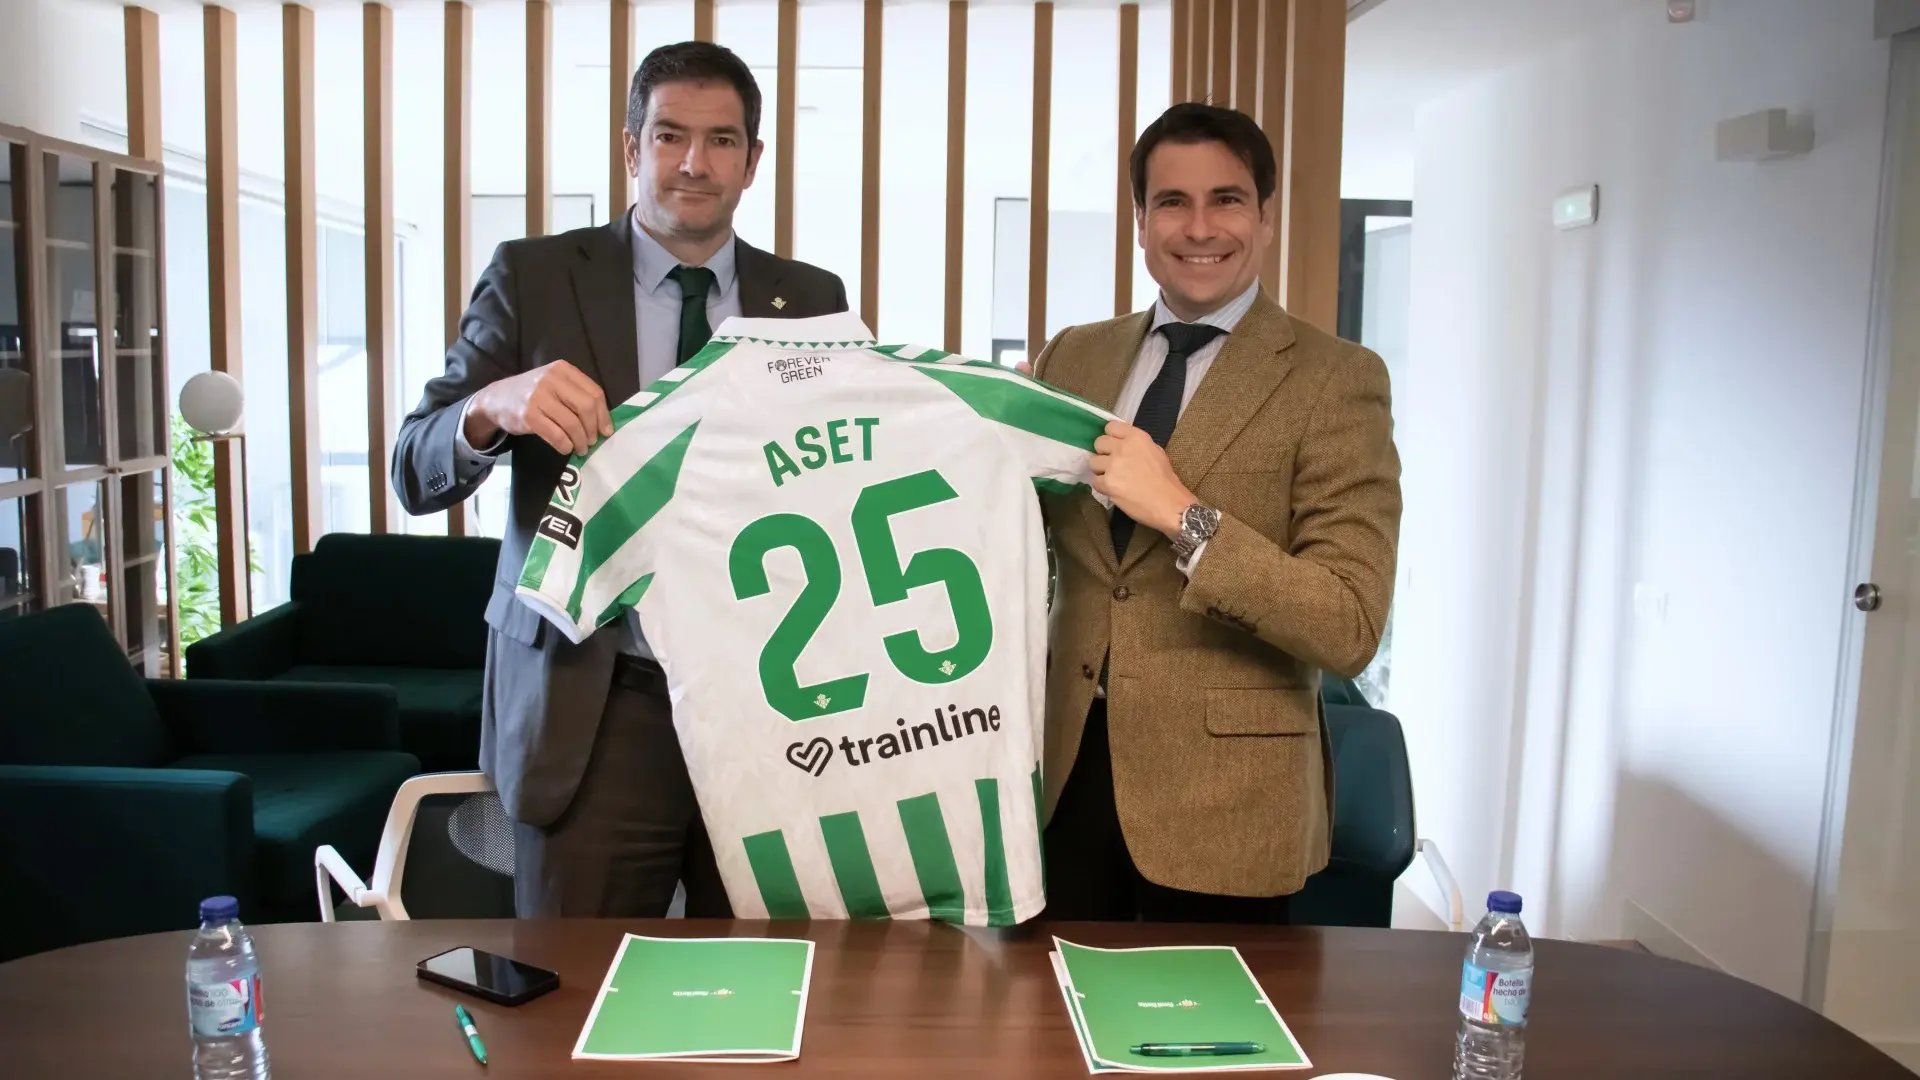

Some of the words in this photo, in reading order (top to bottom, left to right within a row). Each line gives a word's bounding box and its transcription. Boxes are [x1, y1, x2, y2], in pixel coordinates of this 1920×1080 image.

[780, 365, 823, 383] GREEN
[762, 417, 880, 488] ASET
[728, 468, 995, 723] 25
[839, 703, 1001, 767] trainline
